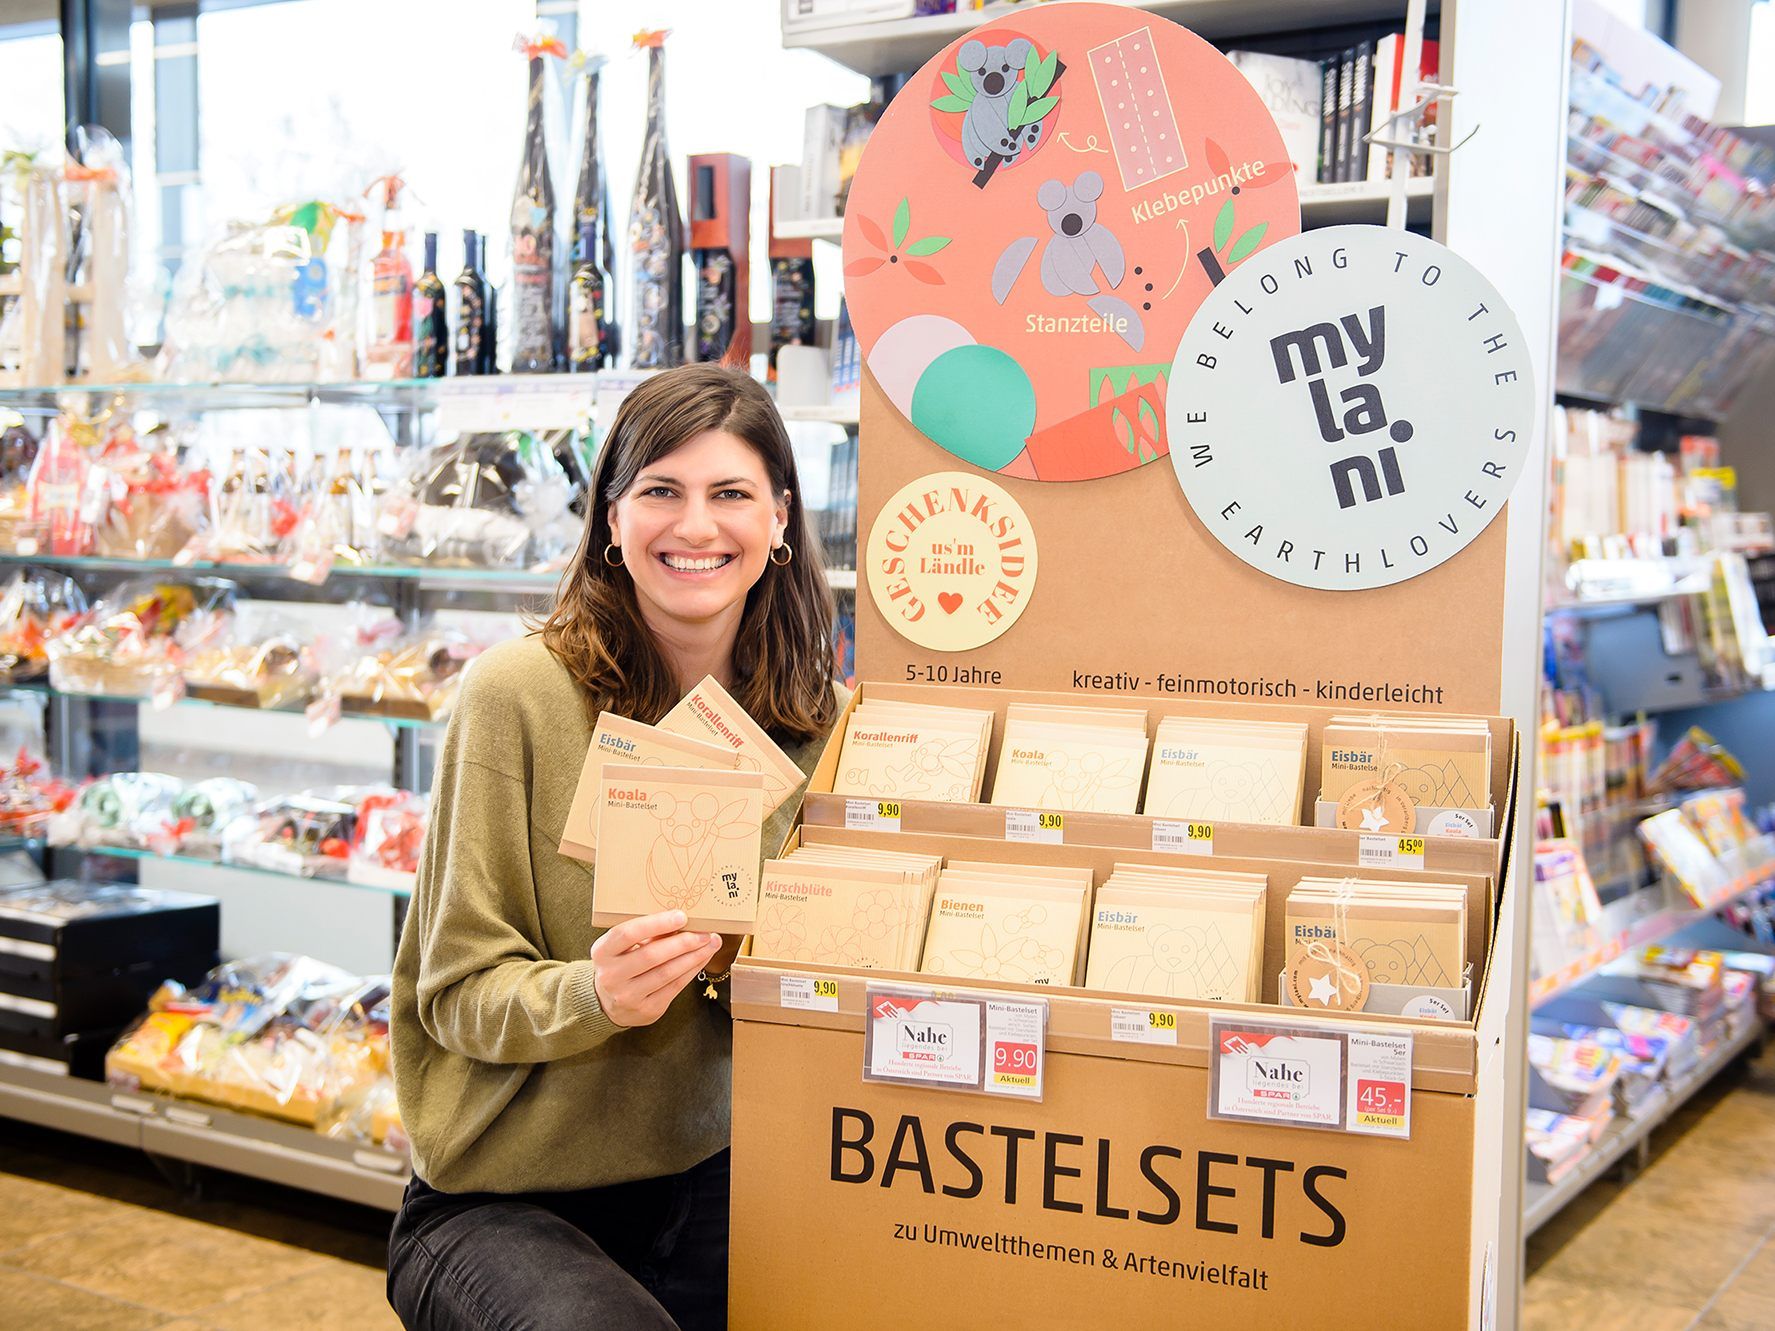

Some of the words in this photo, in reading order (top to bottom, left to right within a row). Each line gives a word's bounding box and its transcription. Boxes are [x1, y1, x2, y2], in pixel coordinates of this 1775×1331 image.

[1131, 157, 1266, 225] Klebepunkte
[1393, 251, 1441, 286] TO
[1196, 248, 1348, 369] BELONG
[1025, 312, 1128, 335] Stanzteile
[1269, 304, 1385, 385] my
[1467, 302, 1517, 386] THE
[1187, 411, 1213, 467] WE
[1220, 428, 1517, 574] EARTHLOVERS
[931, 538, 975, 556] us'm
[881, 487, 1026, 626] GESCHENKSIDEE
[920, 557, 986, 576] Ländle
[905, 664, 948, 683] 5-10
[952, 665, 1002, 685] Jahre
[1072, 669, 1140, 691] kreativ
[1156, 673, 1297, 699] feinmotorisch
[1316, 680, 1444, 705] kinderleicht
[690, 693, 745, 750] Korallenriff
[599, 733, 637, 753] Eisbär
[853, 730, 919, 744] Korallenriff
[597, 745, 641, 762] Mini-Bastelset
[1011, 749, 1045, 760] Koala
[1160, 748, 1199, 760] Eisbär
[1331, 750, 1373, 763] Eisbär
[607, 787, 648, 802] Koala
[607, 800, 658, 811] Mini-Bastelset
[877, 802, 899, 818] 9,90
[1038, 813, 1062, 828] 9,90
[1187, 824, 1212, 839] 9,90
[722, 872, 737, 882] my
[765, 880, 833, 897] Kirschblüte
[765, 892, 808, 902] Mini-Bastelset
[940, 899, 984, 912] Bienen
[1097, 911, 1139, 924] Eisbär
[813, 980, 836, 996] 9,90
[988, 1004, 1038, 1015] Mini-Bastelset
[1149, 1012, 1174, 1028] 9,90
[904, 1024, 947, 1045] Nahe
[1350, 1038, 1407, 1050] Mini-Bastelset
[908, 1053, 936, 1061] SPAR
[995, 1047, 1037, 1069] 9.90
[1393, 1049, 1406, 1057] 5er
[1000, 1075, 1030, 1084] Aktuell
[1252, 1060, 1304, 1083] Nahe
[1259, 1090, 1290, 1099] SPAR
[1360, 1086, 1402, 1108] 45.-
[1363, 1115, 1398, 1125] Aktuell
[829, 1106, 1349, 1249] BASTELSETS
[893, 1222, 919, 1242] zu
[922, 1223, 1096, 1267] Umweltthemen
[1101, 1248, 1119, 1271] &
[1123, 1250, 1269, 1292] Artenvielfalt
